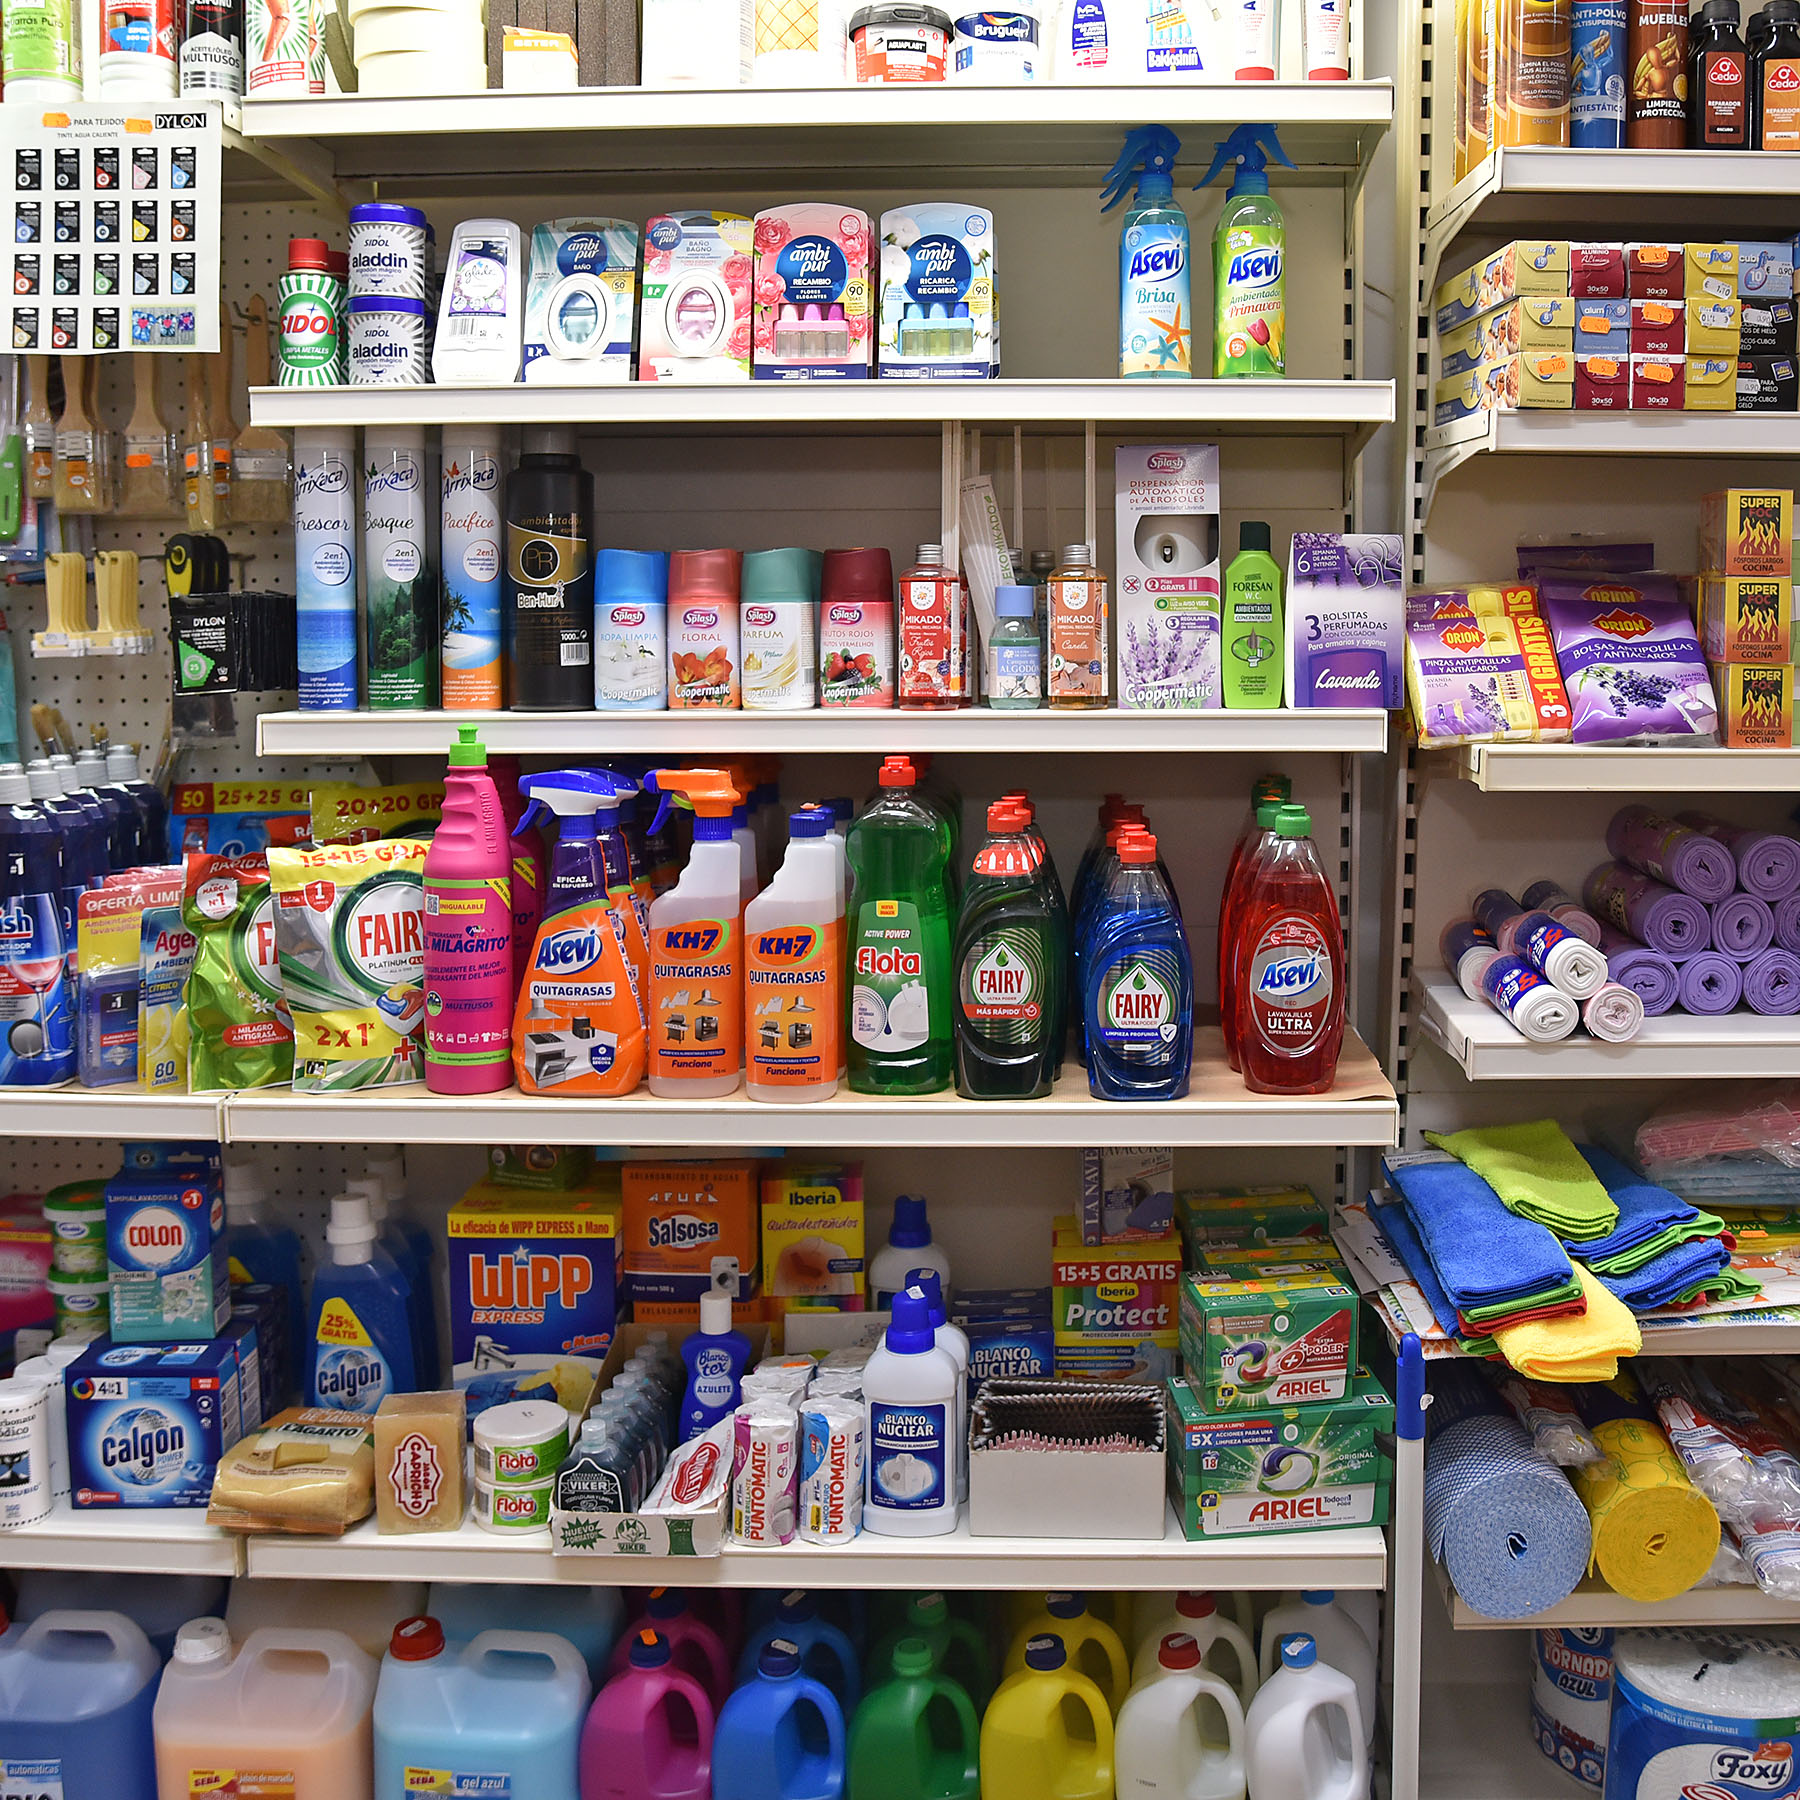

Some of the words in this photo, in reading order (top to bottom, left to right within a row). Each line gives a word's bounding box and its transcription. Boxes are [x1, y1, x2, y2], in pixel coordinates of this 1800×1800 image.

[1639, 14, 1687, 26] MUEBLES
[183, 54, 240, 68] MULTIUSOS
[1711, 72, 1738, 80] Cedar
[1769, 79, 1798, 88] Cedar
[1646, 101, 1680, 109] LIMPIEZA
[74, 118, 93, 126] PARA
[95, 118, 125, 126] TEJIDOS
[156, 114, 205, 129] DYLON
[653, 227, 677, 238] ambi
[364, 239, 390, 247] SIDOL
[352, 253, 408, 268] aladdin
[576, 250, 600, 262] pur
[793, 278, 832, 286] RECAMBIO
[849, 286, 863, 295] 90
[975, 286, 988, 295] 90
[1136, 288, 1175, 304] Brisa
[352, 344, 408, 358] aladdin
[1130, 479, 1205, 488] DISPENSADOR
[1130, 486, 1205, 495] AUTOMÁTICO
[1740, 497, 1779, 509] SUPER
[1748, 508, 1772, 518] FOC
[1742, 564, 1774, 572] COCINA
[1233, 582, 1273, 592] FORESAN
[1739, 584, 1778, 596] SUPER
[1235, 605, 1271, 613] AMBIENTADOR
[747, 609, 775, 621] Splash
[831, 609, 859, 621] Splash
[905, 615, 942, 624] MIKADO
[1057, 615, 1094, 624] MIKADO
[1323, 611, 1368, 621] BOLSITAS
[192, 616, 226, 626] DYLON
[1324, 621, 1388, 631] PERFUMADAS
[626, 633, 658, 641] LIMPIA
[681, 633, 722, 642] FLORAL
[909, 636, 934, 647] Frutos
[1446, 632, 1480, 644] ORION
[1061, 639, 1088, 651] Canela
[1742, 650, 1773, 659] COCINA
[1456, 658, 1511, 666] ANTIPOLILLAS
[1315, 669, 1382, 689] Lavanda
[1743, 669, 1782, 681] SUPER
[675, 683, 730, 699] Coopermatic
[1125, 680, 1214, 702] Coopermatic
[1752, 680, 1775, 691] FOC
[1746, 736, 1778, 744] COCINA
[556, 876, 588, 884] EFICAZ
[864, 930, 884, 938] ACTIVE
[885, 929, 911, 939] POWER
[368, 958, 408, 969] PLATINUM
[654, 963, 732, 979] QUITAGRASAS
[979, 970, 1025, 994] FAIRY
[533, 985, 613, 997] QUITAGRASAS
[445, 1000, 494, 1010] MULTIUSOS
[976, 1007, 991, 1016] MÁS
[993, 1007, 1019, 1016] RÁPIDO
[237, 1023, 273, 1034] MILAGRO
[1268, 1018, 1313, 1030] ULTRA
[232, 1030, 276, 1042] ANTIGRASA
[155, 1060, 176, 1078] 80
[671, 1059, 712, 1069] Funciona
[766, 1066, 806, 1076] Funciona
[151, 1076, 178, 1087] LAVADOS
[789, 1192, 836, 1206] Iberia
[451, 1221, 461, 1233] La
[463, 1220, 497, 1233] eficacia
[499, 1222, 510, 1233] de
[512, 1222, 533, 1233] WIPP
[536, 1222, 575, 1234] EXPRESS
[577, 1224, 582, 1233] a
[585, 1222, 609, 1234] Mano
[649, 1216, 719, 1247] Salsosa
[1725, 1223, 1766, 1231] SUAVE
[128, 1224, 183, 1247] COLON
[1058, 1266, 1102, 1281] 15+5
[1106, 1264, 1176, 1281] GRATIS
[1100, 1287, 1135, 1297] Iberia
[472, 1311, 545, 1323] EXPRESS
[1066, 1304, 1170, 1327] Protect
[326, 1314, 354, 1330] 25%
[321, 1328, 358, 1340] GRATIS
[1307, 1344, 1343, 1354] PODER
[974, 1347, 1031, 1363] BLANCO
[1223, 1356, 1234, 1366] 10
[696, 1384, 731, 1393] AZULETE
[885, 1414, 926, 1426] BLANCO
[878, 1422, 934, 1437] NUCLEAR
[102, 1422, 185, 1468] Calgon
[1243, 1436, 1271, 1444] INCREÍBLE
[1339, 1452, 1374, 1460] ORIGINAL
[1205, 1458, 1217, 1469] 18
[411, 1441, 422, 1510] CAPRICHO
[570, 1481, 608, 1491] VIKER
[750, 1442, 766, 1540] PUNTOMATIC
[564, 1525, 594, 1537] NUEVO
[618, 1543, 645, 1551] VIKER
[1558, 1674, 1595, 1697] AZUL
[1717, 1754, 1786, 1785] Foxy
[194, 1776, 221, 1788] SEBA
[409, 1776, 435, 1787] SEBA
